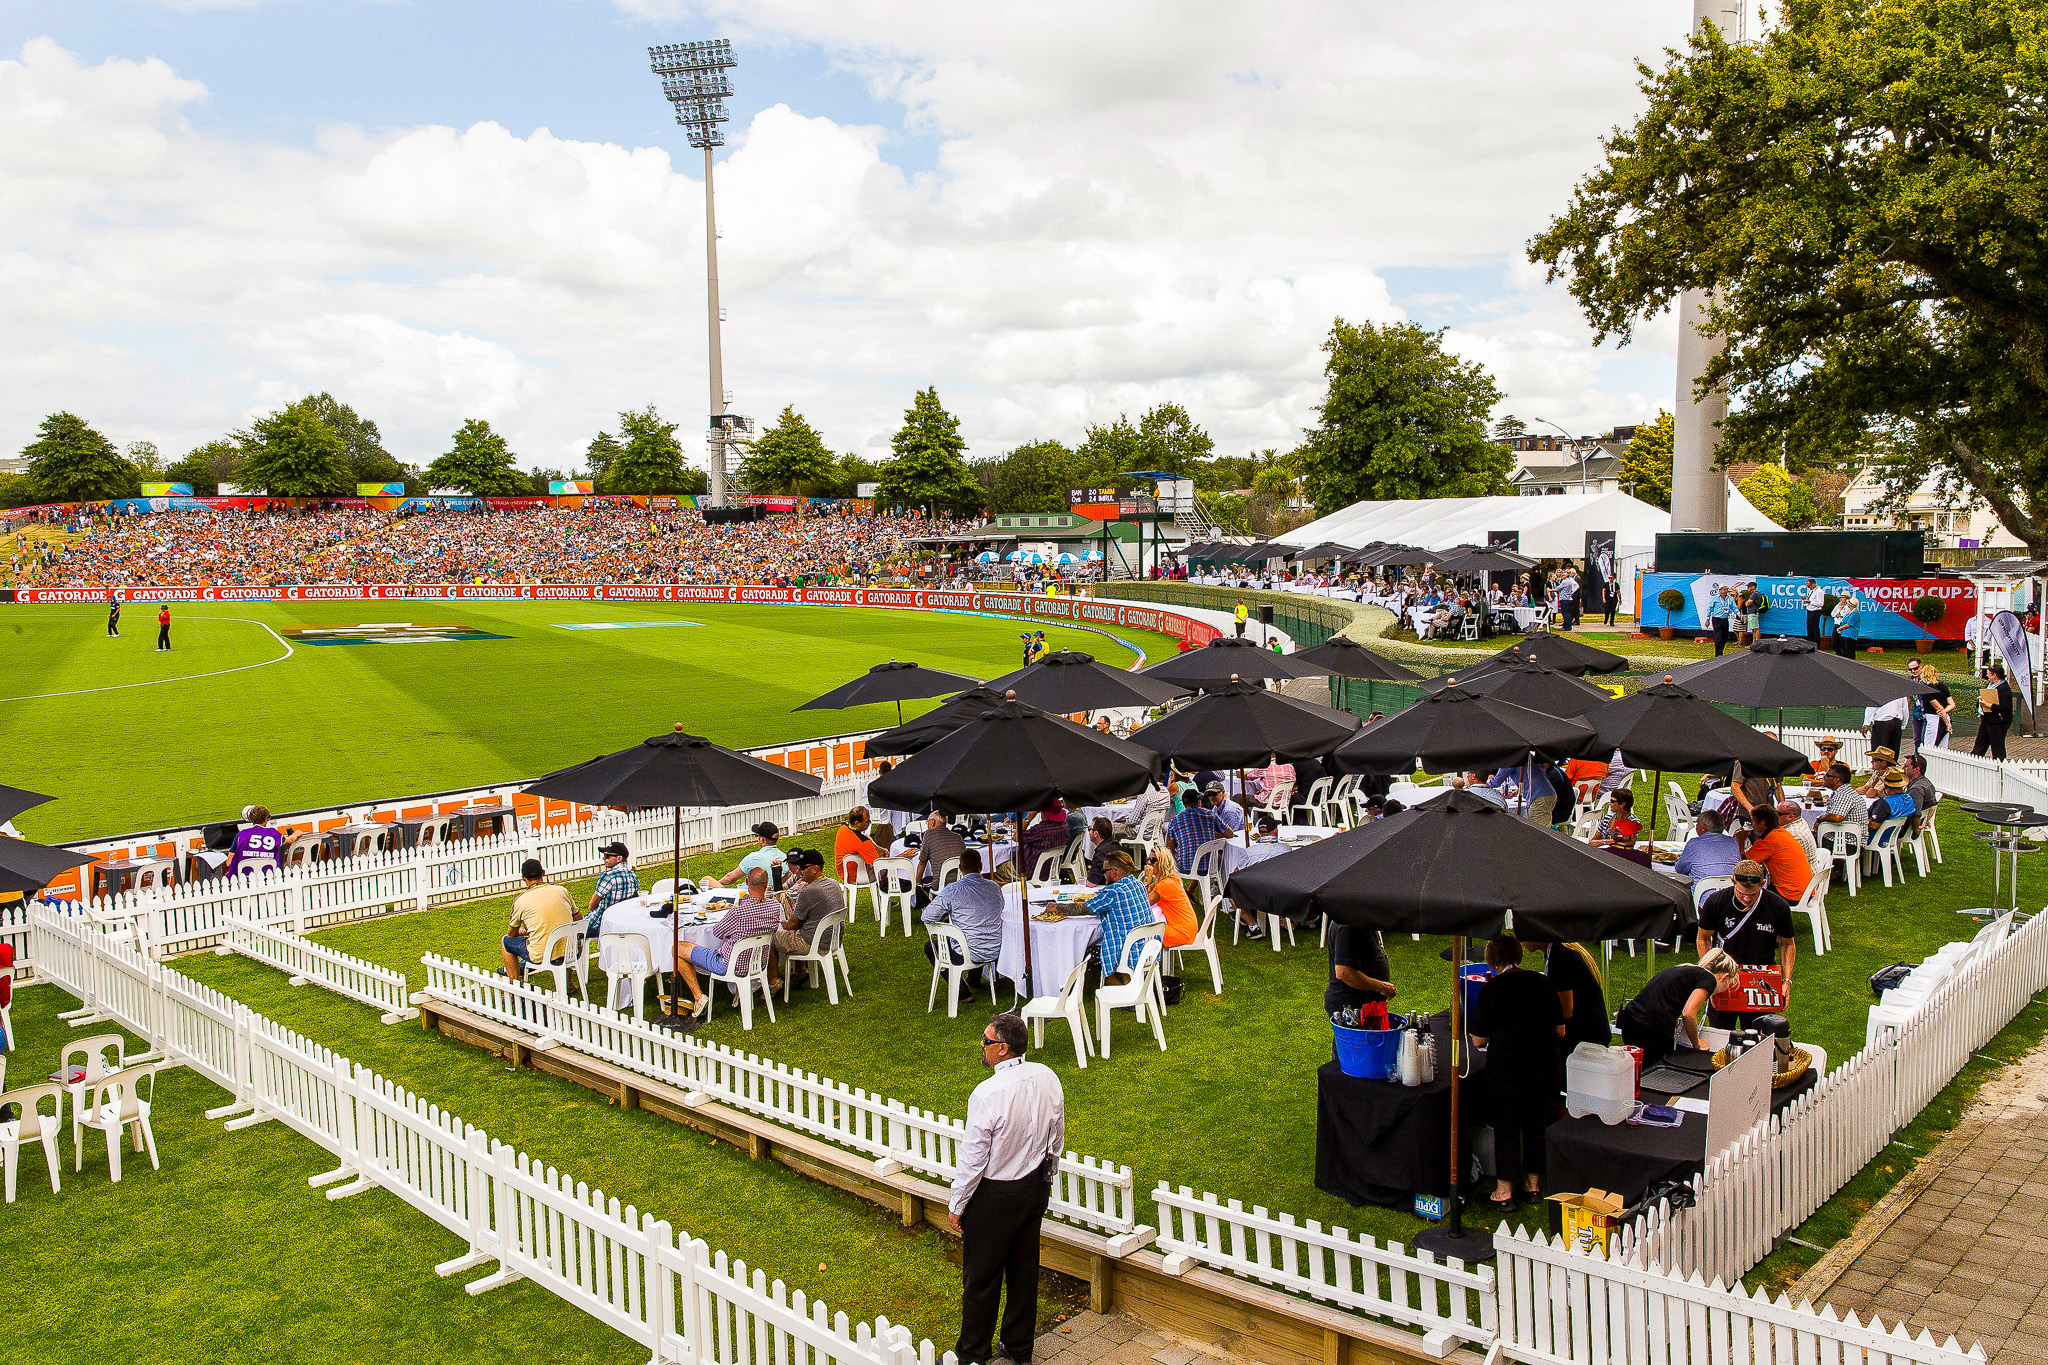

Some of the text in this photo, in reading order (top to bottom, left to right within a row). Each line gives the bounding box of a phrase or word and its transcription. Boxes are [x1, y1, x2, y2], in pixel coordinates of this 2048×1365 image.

[38, 591, 107, 600] GATORADE
[133, 590, 197, 599] GATORADE
[221, 589, 282, 598] GATORADE
[305, 588, 363, 597] GATORADE
[385, 588, 442, 597] GATRADE
[463, 588, 516, 597] GATORADE
[536, 588, 589, 597] GATORADE
[608, 588, 659, 597] GATORADE
[677, 588, 724, 598] GATORADE
[742, 589, 788, 600] GATORADE
[806, 590, 852, 602] GATORADE
[868, 592, 912, 604] GATORADE
[1771, 584, 1795, 596] ICC
[1797, 586, 1860, 600] CCKET
[1864, 587, 1925, 599] WORLD
[1927, 587, 1962, 599] CUP
[928, 594, 970, 606] GATORADE
[984, 596, 1021, 610] GATORADE
[1770, 598, 1807, 609] AUSTR
[1882, 602, 1914, 612] ZEAL
[1034, 601, 1070, 616] GATORADE
[1082, 605, 1116, 621] GATORADE
[1128, 610, 1156, 628] GATORADE
[249, 834, 276, 850] 59
[1743, 988, 1780, 1006] Tui
